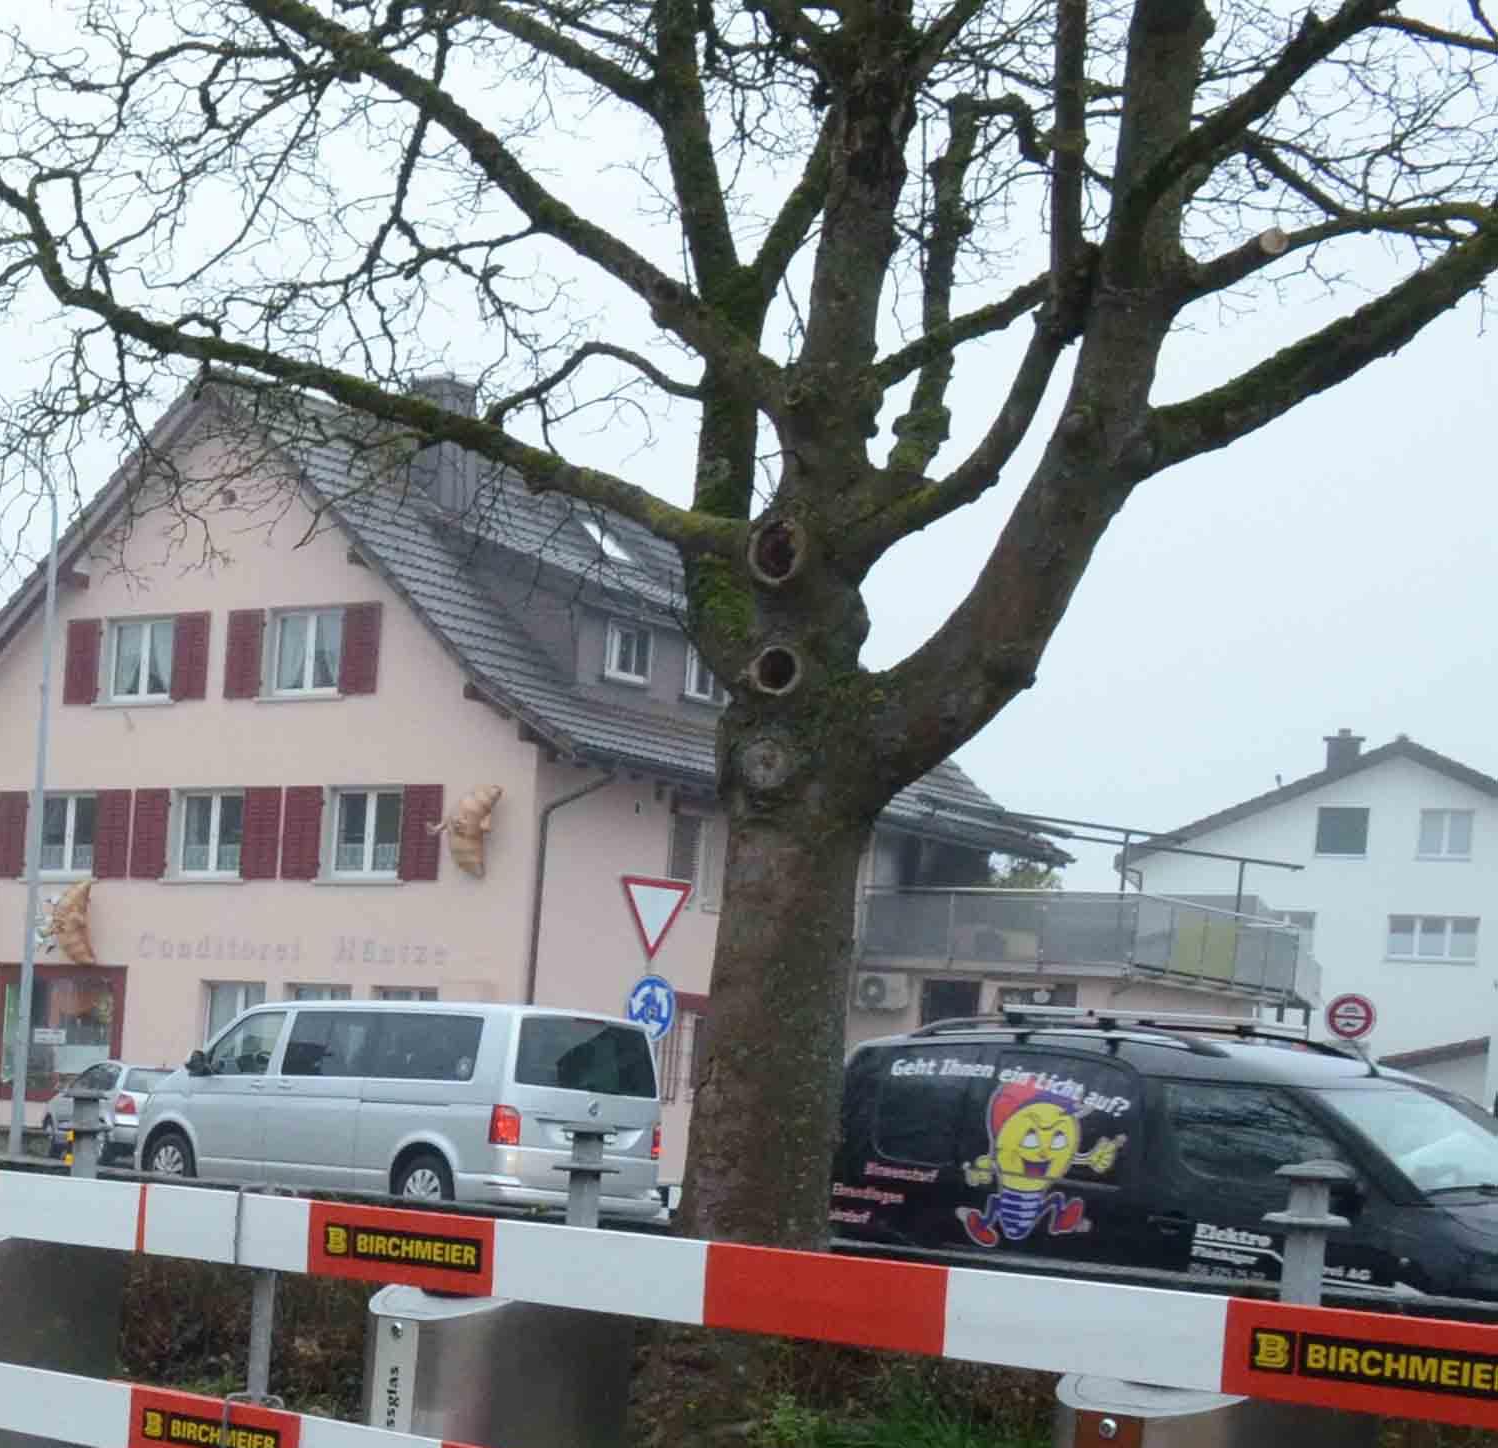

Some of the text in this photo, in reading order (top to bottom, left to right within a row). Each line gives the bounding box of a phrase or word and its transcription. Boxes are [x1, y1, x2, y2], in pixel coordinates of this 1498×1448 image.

[891, 1057, 1131, 1117] Geht Ihnen ein Licht auf?
[356, 1231, 478, 1267] BIRCHMEIER
[1194, 1222, 1273, 1248] Elektro
[386, 1365, 402, 1428] ssglas
